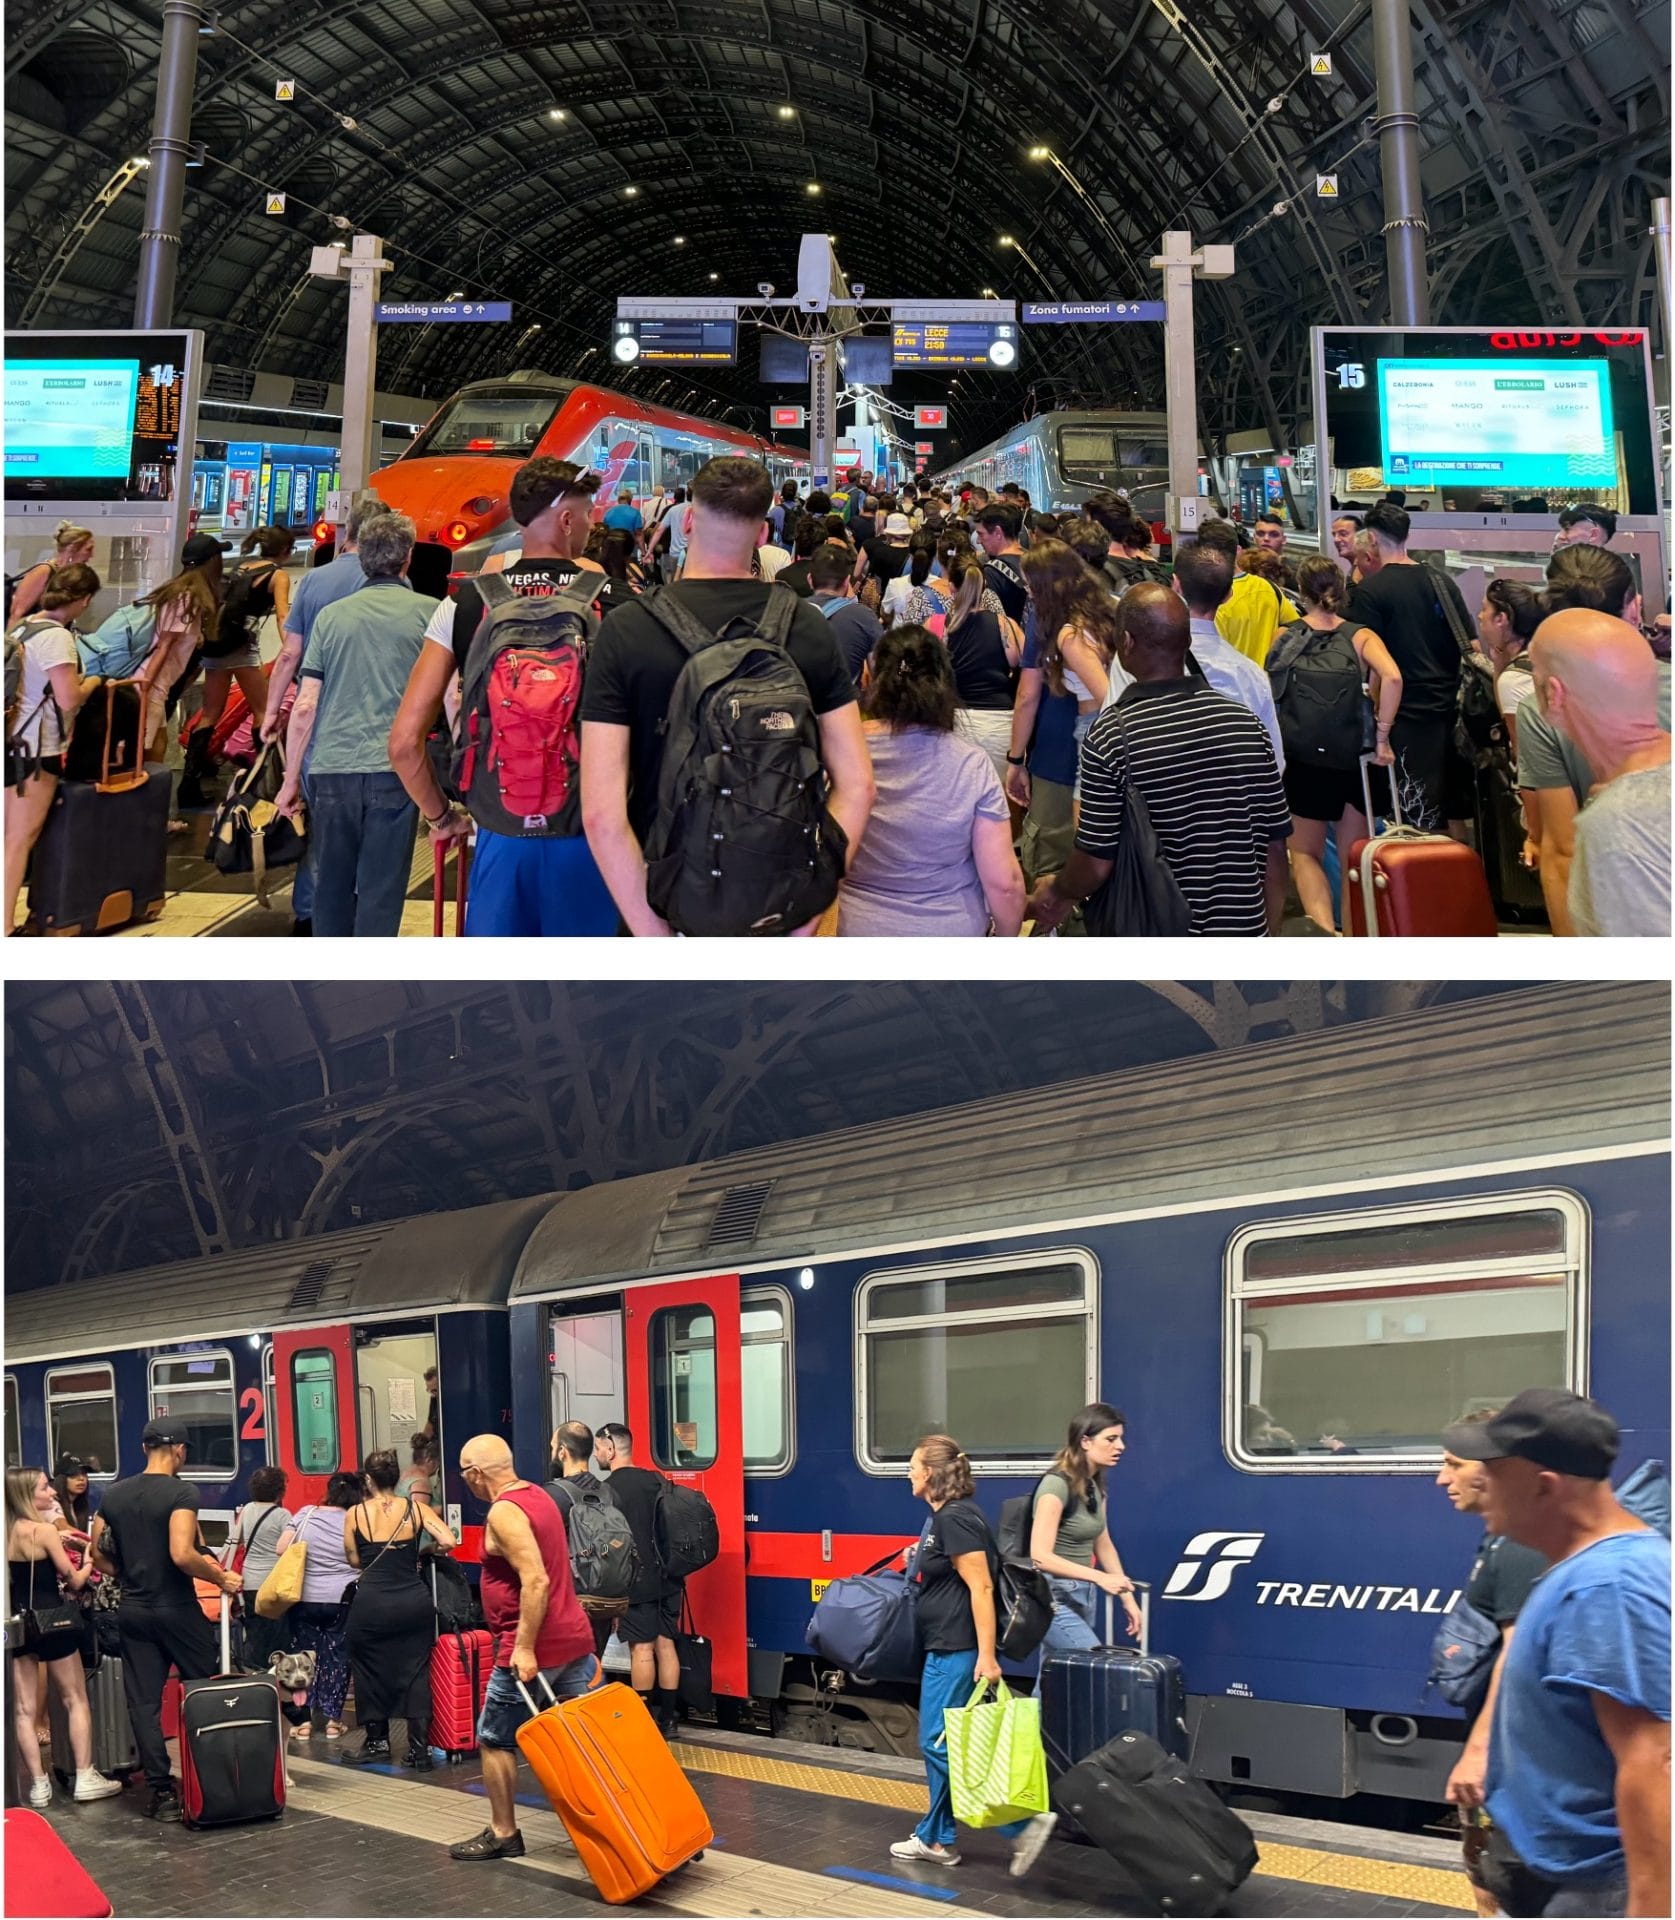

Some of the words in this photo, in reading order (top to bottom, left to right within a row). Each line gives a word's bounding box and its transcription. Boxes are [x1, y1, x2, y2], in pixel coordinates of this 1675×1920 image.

[381, 305, 428, 316] Smoking
[431, 306, 456, 314] area
[1029, 304, 1058, 314] Zona
[1062, 303, 1109, 313] fumatori
[924, 328, 949, 337] LECCE
[150, 364, 174, 387] 14
[1336, 363, 1365, 388] 15
[327, 500, 338, 509] 14
[1183, 506, 1195, 517] 15
[506, 572, 550, 586] VEGAS
[240, 1387, 265, 1440] 2
[1256, 1581, 1463, 1614] TRENITALI
